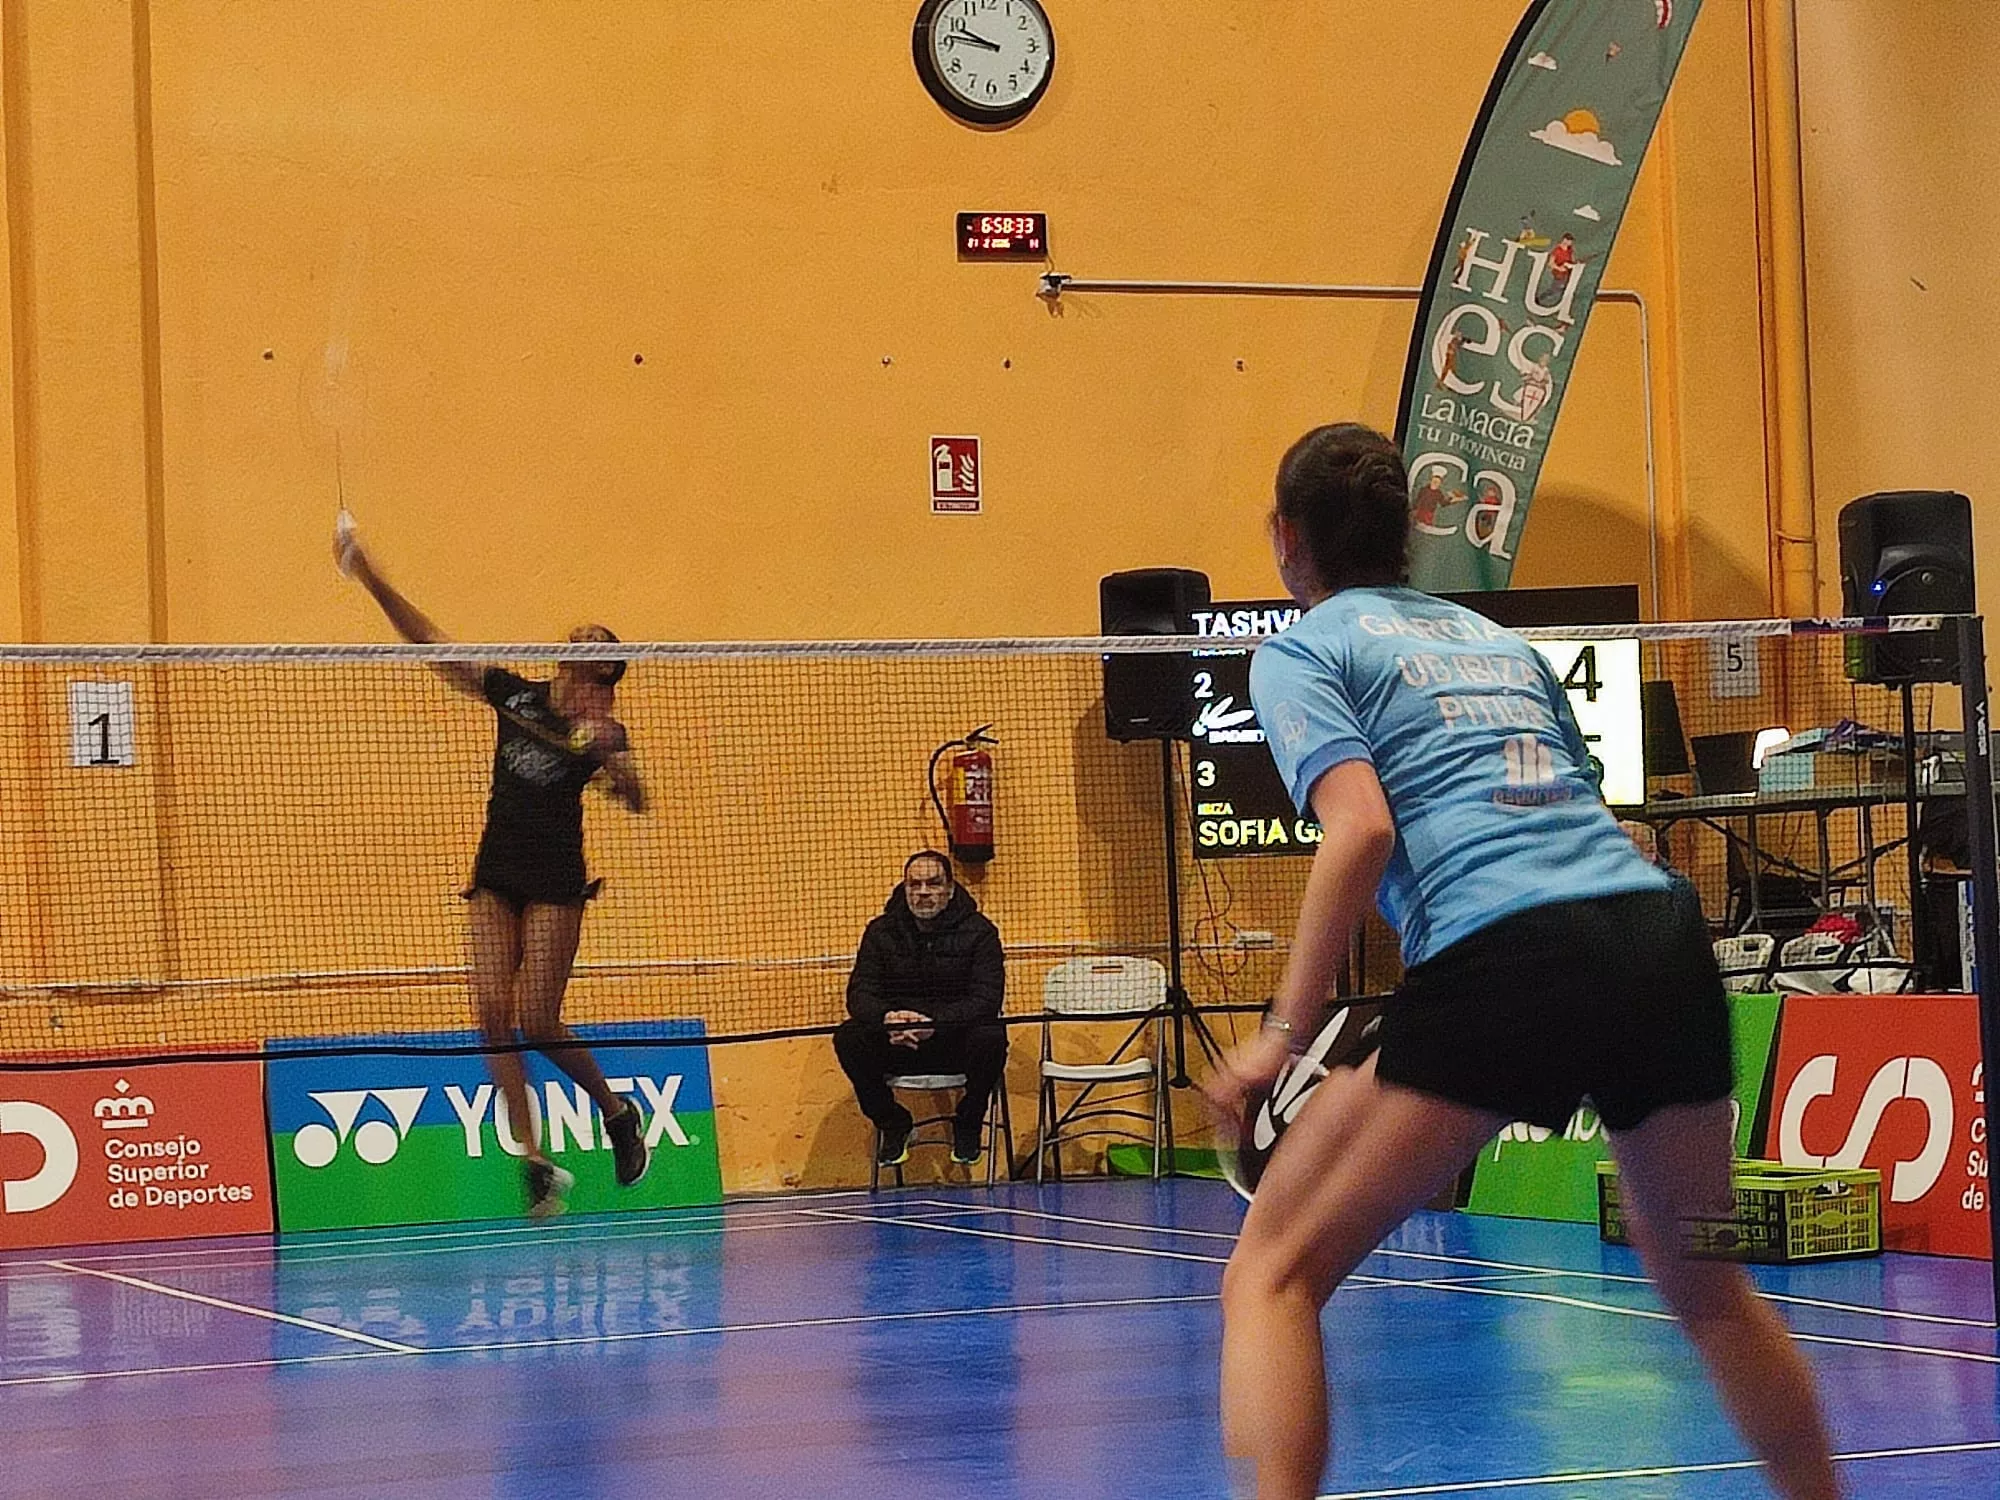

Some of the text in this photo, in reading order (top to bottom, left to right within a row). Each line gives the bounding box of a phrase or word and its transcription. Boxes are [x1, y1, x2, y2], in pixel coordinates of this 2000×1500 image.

[963, 1, 977, 16] 11
[1006, 1, 1011, 16] 1
[950, 17, 966, 32] 10
[1018, 15, 1028, 30] 2
[944, 35, 955, 52] 9
[1027, 38, 1037, 53] 3
[951, 58, 962, 73] 8
[1020, 58, 1030, 74] 4
[968, 73, 977, 88] 7
[986, 79, 997, 94] 6
[1008, 74, 1018, 91] 5
[1726, 643, 1744, 673] 5
[1563, 645, 1604, 702] 4
[1193, 672, 1214, 699] 2
[88, 713, 120, 765] 1
[1197, 760, 1216, 787] 3
[1199, 817, 1324, 846] SOFIA G
[105, 1135, 201, 1160] Consejo
[108, 1160, 209, 1186] Superior
[109, 1183, 253, 1210] de Deportes
[1962, 1182, 1985, 1211] de
